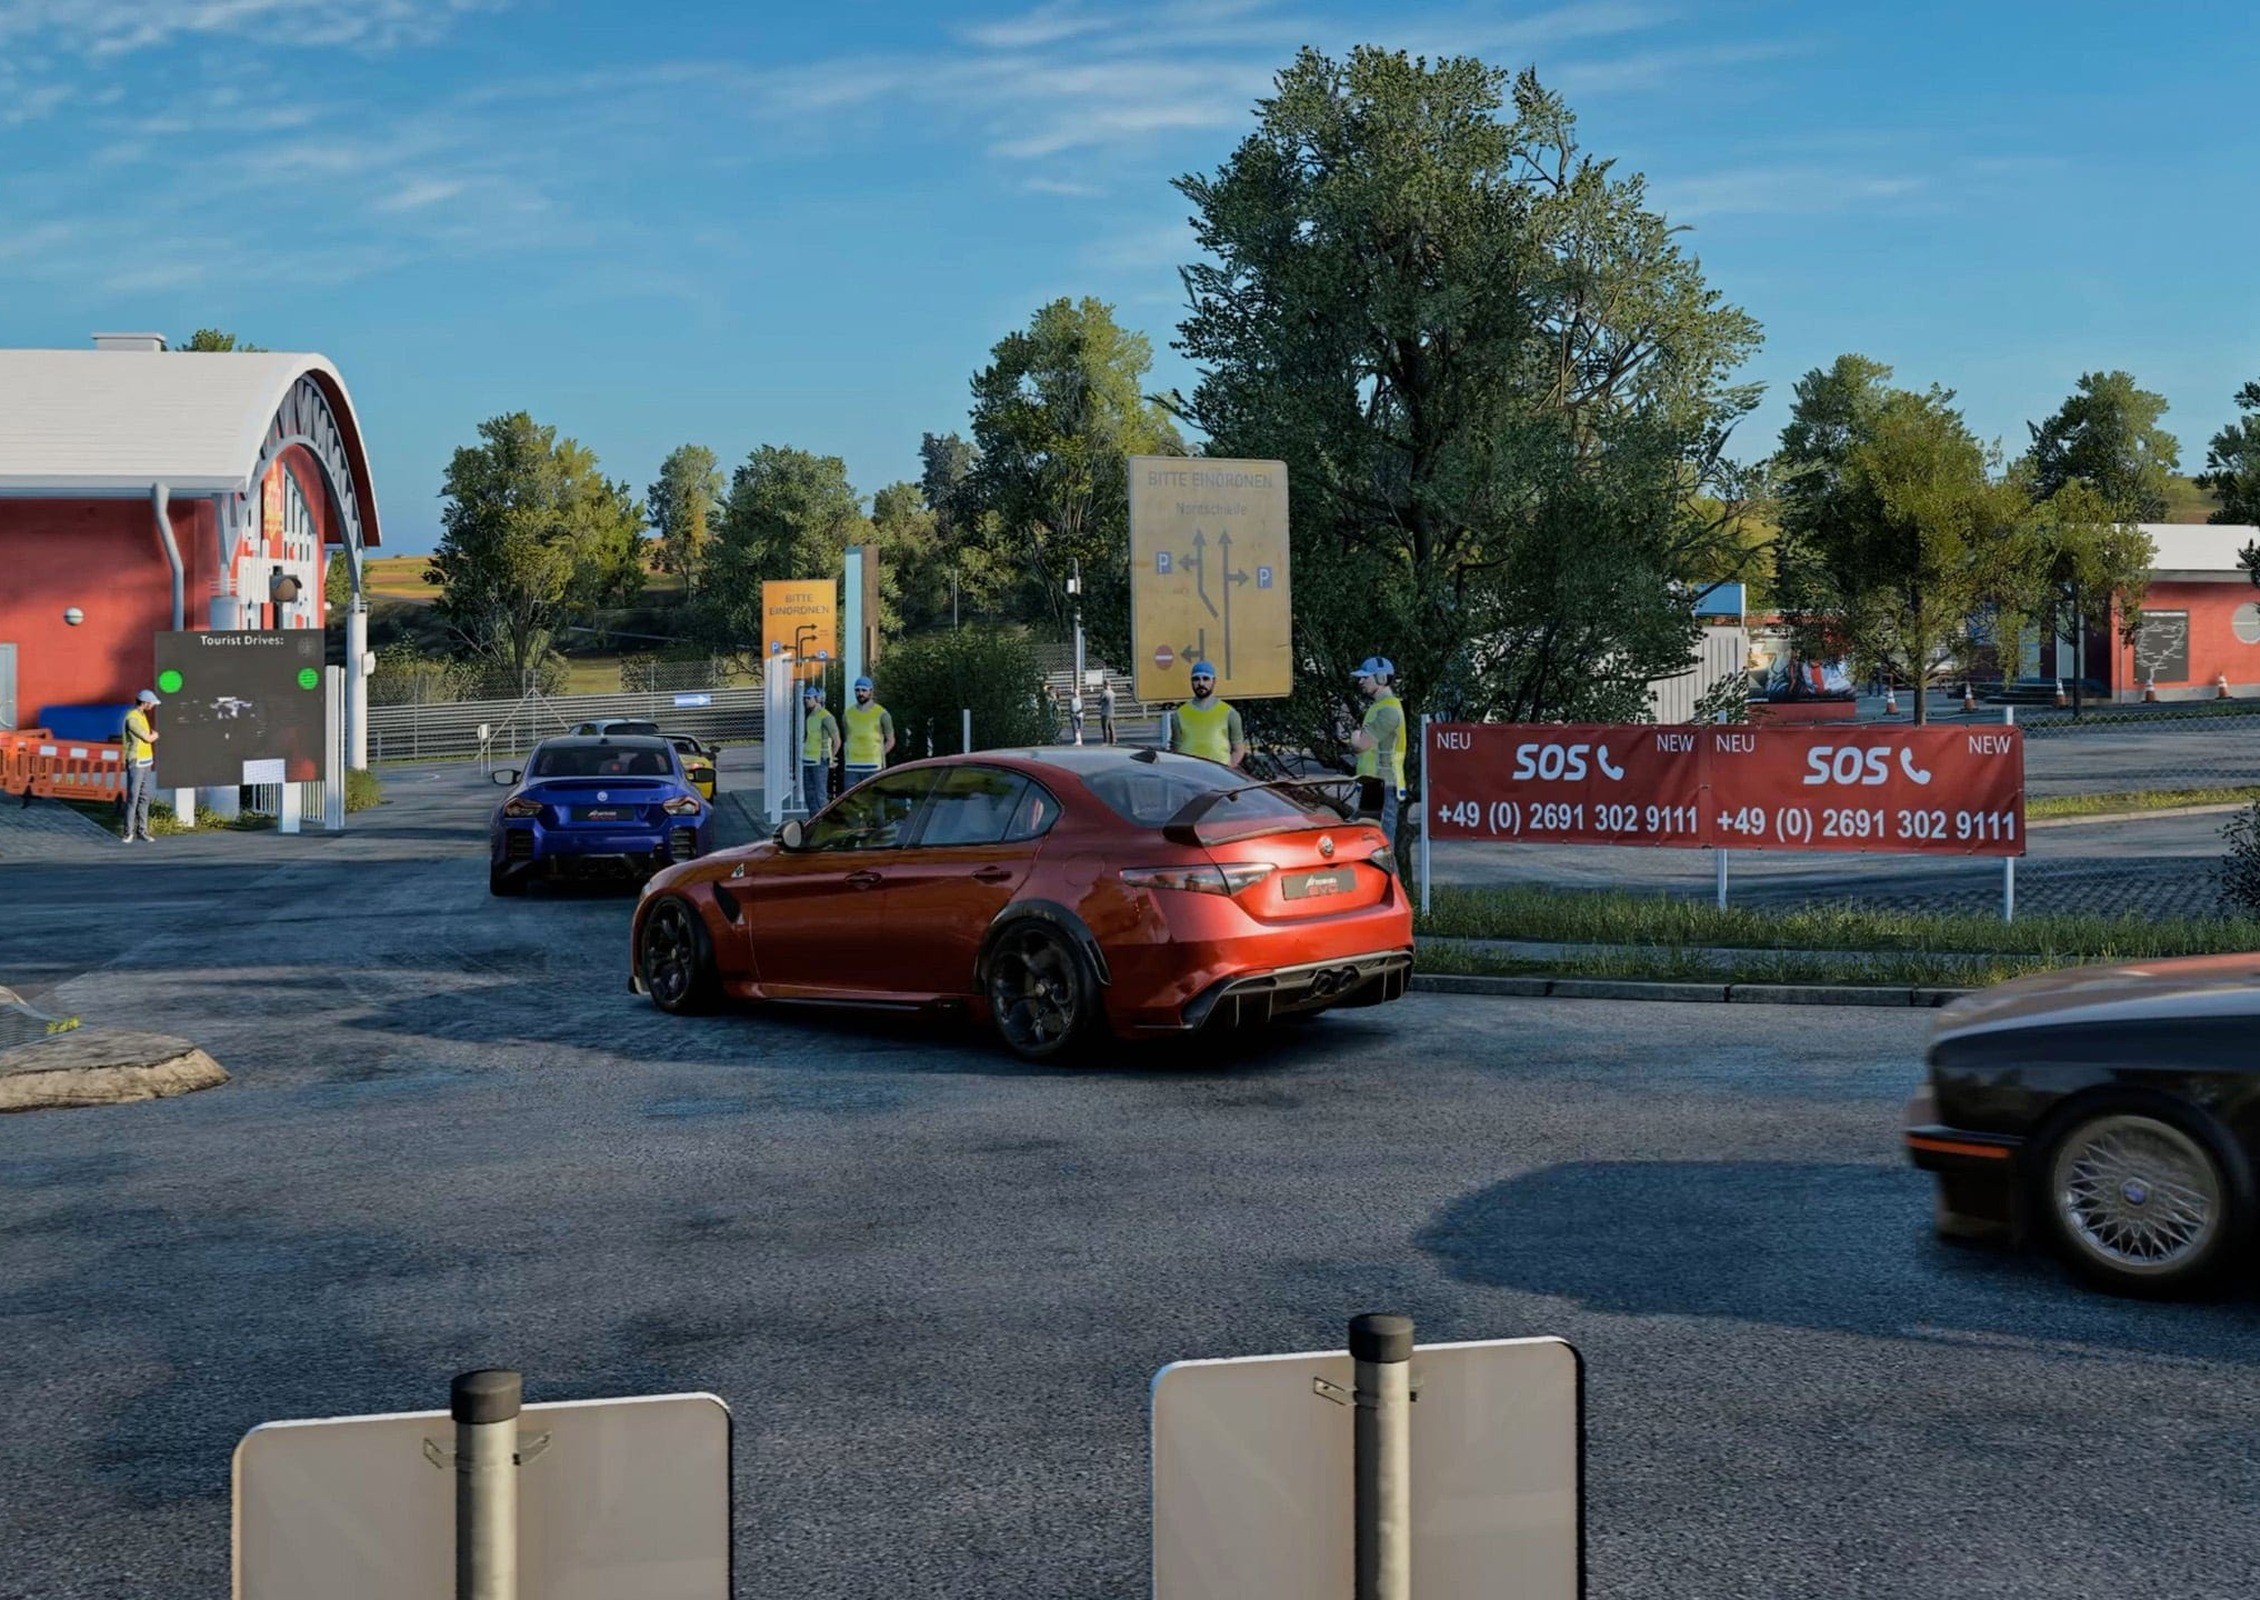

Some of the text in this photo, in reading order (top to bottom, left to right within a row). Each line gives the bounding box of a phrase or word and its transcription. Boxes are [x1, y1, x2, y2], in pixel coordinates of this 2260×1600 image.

[1148, 471, 1189, 487] BITTE
[1159, 553, 1169, 573] P
[1259, 568, 1270, 587] P
[785, 594, 814, 603] BITTE
[200, 635, 284, 646] Tourist Drives:
[1437, 732, 1471, 750] NEU
[1656, 734, 1694, 752] NEW
[1716, 734, 1755, 753] NEU
[1968, 736, 2011, 754] NEW
[1512, 744, 1590, 781] SOS
[1803, 746, 1892, 785] SOS
[1438, 801, 1697, 835] +49 (0) 2691 302 9111
[1716, 807, 2015, 843] +49 (0) 2691 302 9111
